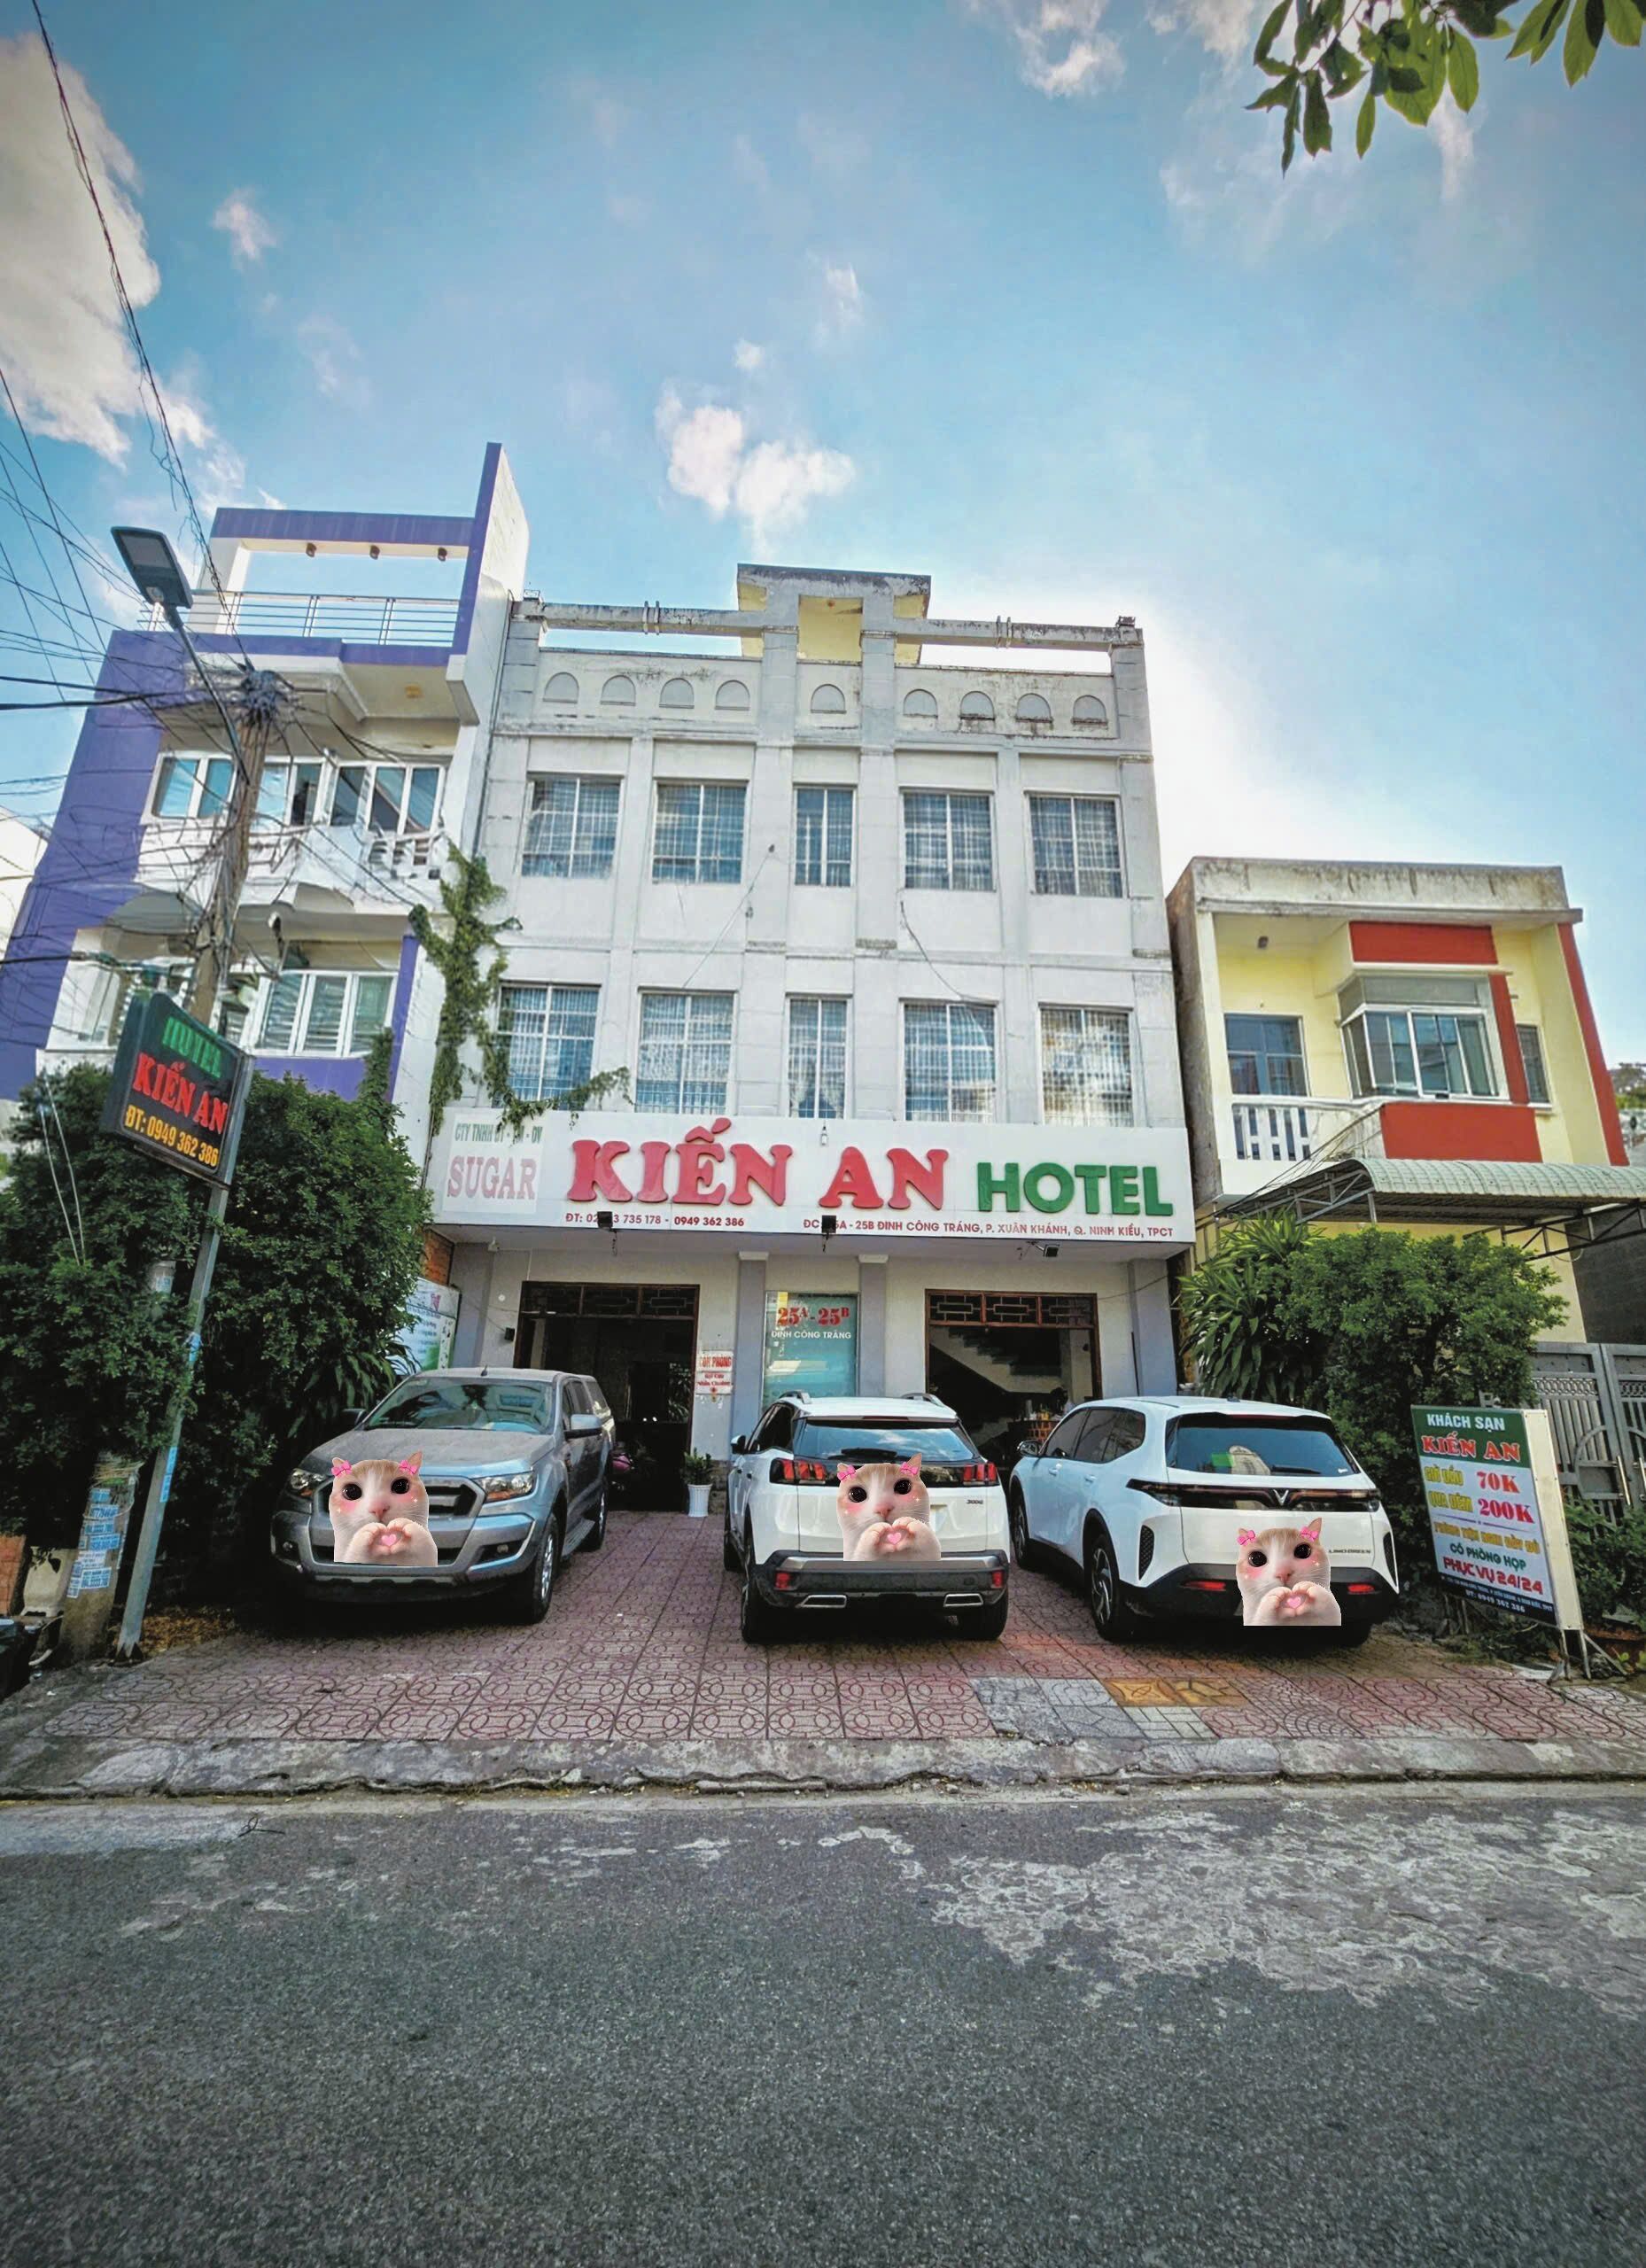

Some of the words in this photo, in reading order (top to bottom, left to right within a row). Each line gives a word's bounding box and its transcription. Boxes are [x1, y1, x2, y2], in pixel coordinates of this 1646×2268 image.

[162, 1015, 221, 1079] HOTEL
[133, 1052, 196, 1117] KIẾN
[193, 1091, 228, 1134] AN
[125, 1105, 146, 1134] ĐT:
[147, 1115, 176, 1146] 0949
[178, 1131, 198, 1158] 362
[198, 1141, 219, 1168] 386
[472, 1123, 493, 1142] TNHH
[446, 1154, 537, 1200] SUGAR
[567, 1117, 793, 1207] KIẾN
[819, 1146, 949, 1211] AN
[977, 1161, 1174, 1216] HOTEL
[565, 1213, 583, 1223] ĐT:
[586, 1213, 619, 1223] 023
[623, 1214, 642, 1224] 735
[645, 1215, 661, 1224] 178
[674, 1216, 700, 1226] 0949
[703, 1216, 725, 1226] 362
[725, 1217, 745, 1227] 386
[856, 1220, 874, 1231] 25B
[877, 1221, 903, 1231] ĐINH
[905, 1219, 940, 1232] CÔNG
[943, 1219, 983, 1234] TRÁNG,
[985, 1222, 995, 1233] P.
[998, 1223, 1028, 1234] XUÂN
[1030, 1223, 1071, 1236] KHÁNH,
[1074, 1226, 1086, 1236] Q.
[1089, 1226, 1115, 1236] NINH
[1118, 1223, 1145, 1239] KIỀU,
[1147, 1227, 1174, 1237] TPCT
[818, 1307, 850, 1326] 25B
[794, 1330, 821, 1340] CÔNG
[823, 1329, 851, 1340] TRÁNG
[1426, 1412, 1471, 1429] KHÁCH
[1474, 1417, 1505, 1433] SẠN
[1421, 1431, 1477, 1458] KIẾN
[1483, 1441, 1520, 1463] AN
[1476, 1471, 1520, 1494] 70K
[1478, 1498, 1533, 1524] 200K
[1449, 1542, 1464, 1556] CÓ
[1466, 1546, 1502, 1565] PHÒNG
[1503, 1555, 1526, 1573] HỌP
[1443, 1556, 1476, 1577] PHỤC
[1475, 1565, 1495, 1584] VỤ
[1495, 1571, 1543, 1596] 24/24
